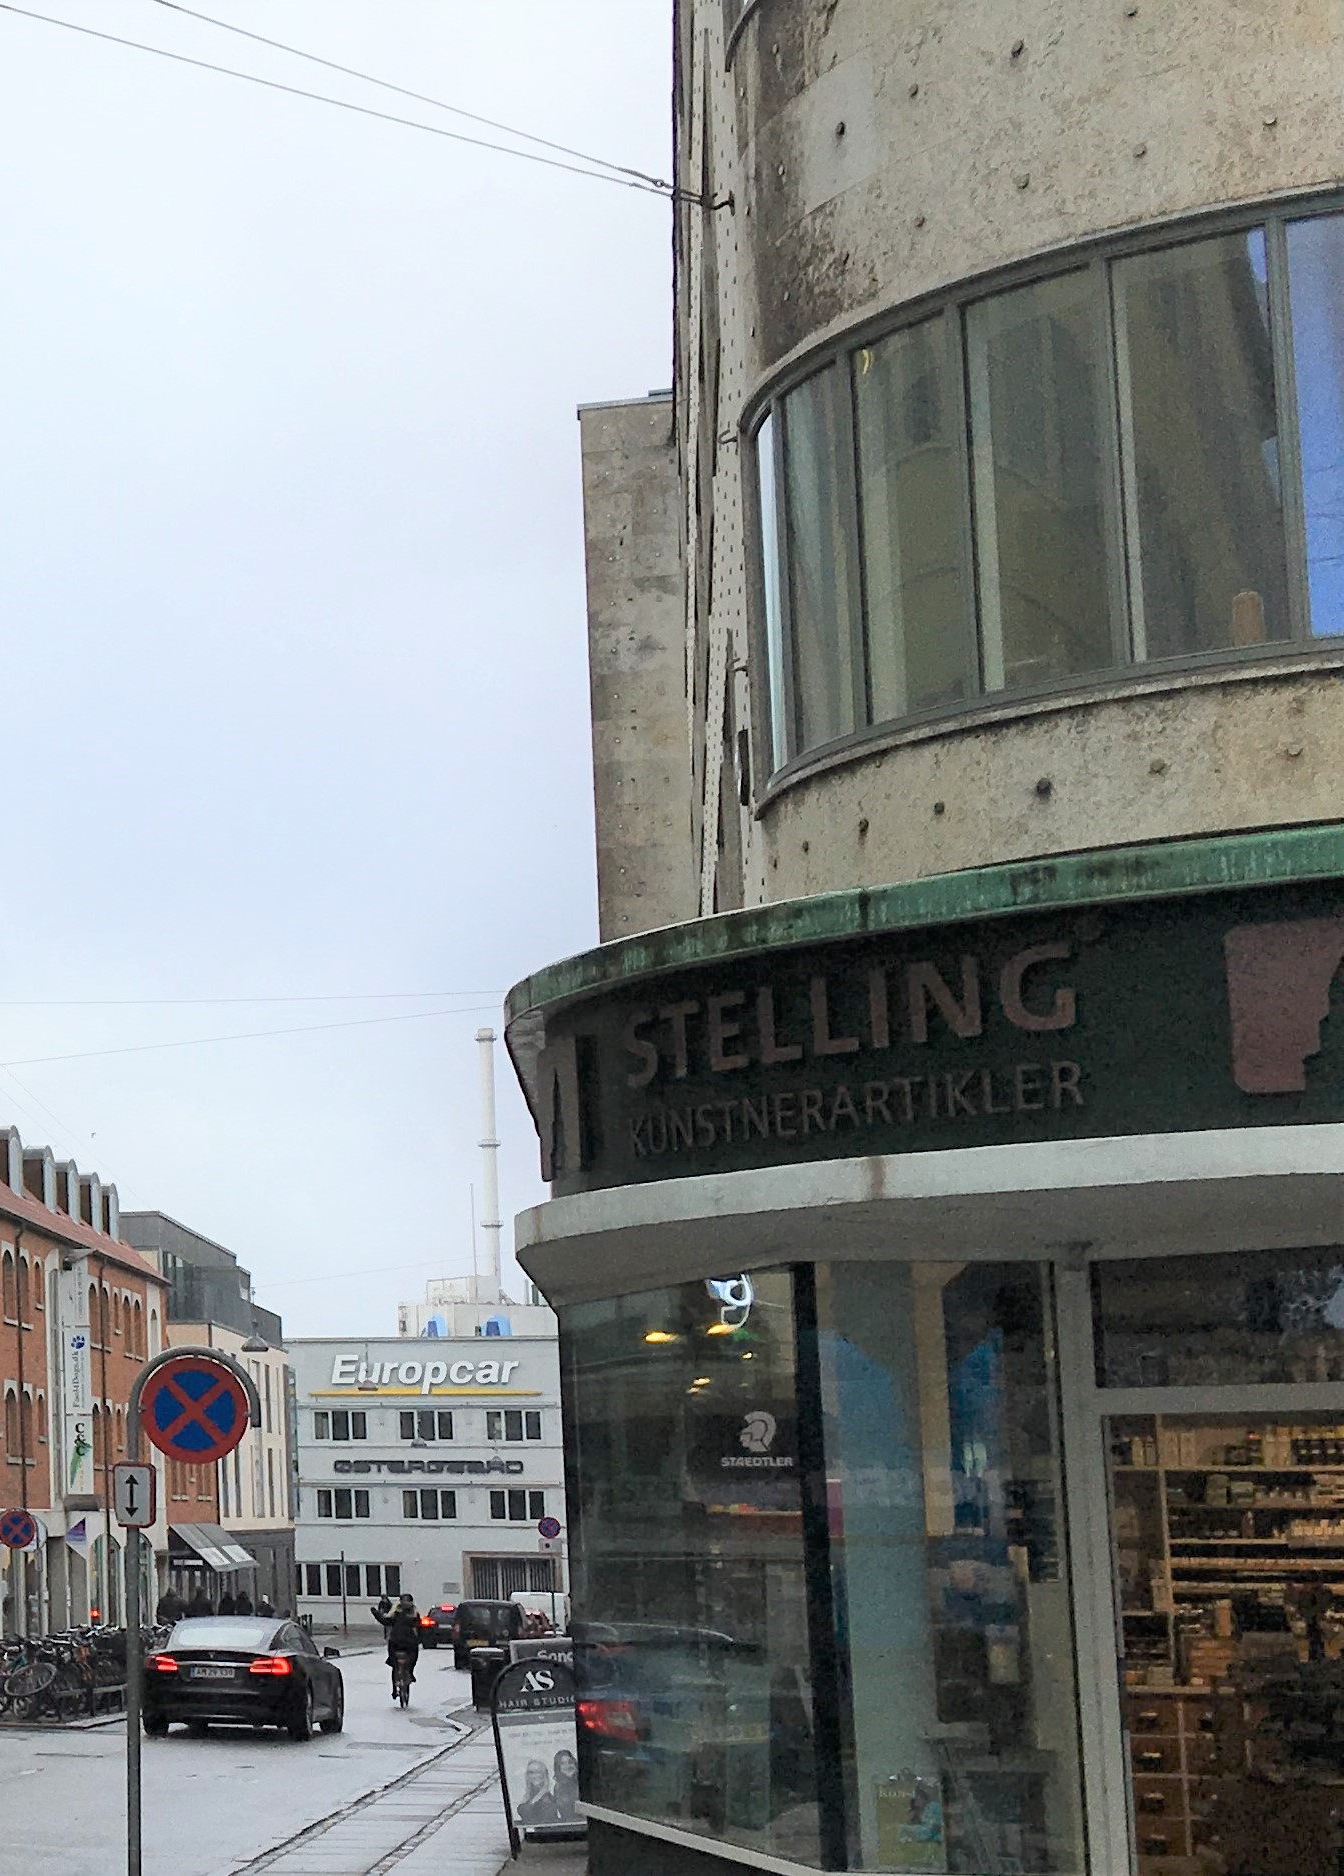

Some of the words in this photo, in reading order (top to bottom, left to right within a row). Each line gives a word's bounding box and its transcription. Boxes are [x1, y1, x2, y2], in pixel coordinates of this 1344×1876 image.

[627, 943, 1077, 1089] STELLING
[628, 1060, 1085, 1158] KUNSTNERARTIKLER
[331, 1354, 519, 1395] Europcar
[720, 1457, 793, 1467] STAEDTLER
[520, 1670, 554, 1693] AS
[498, 1699, 528, 1708] HAIR
